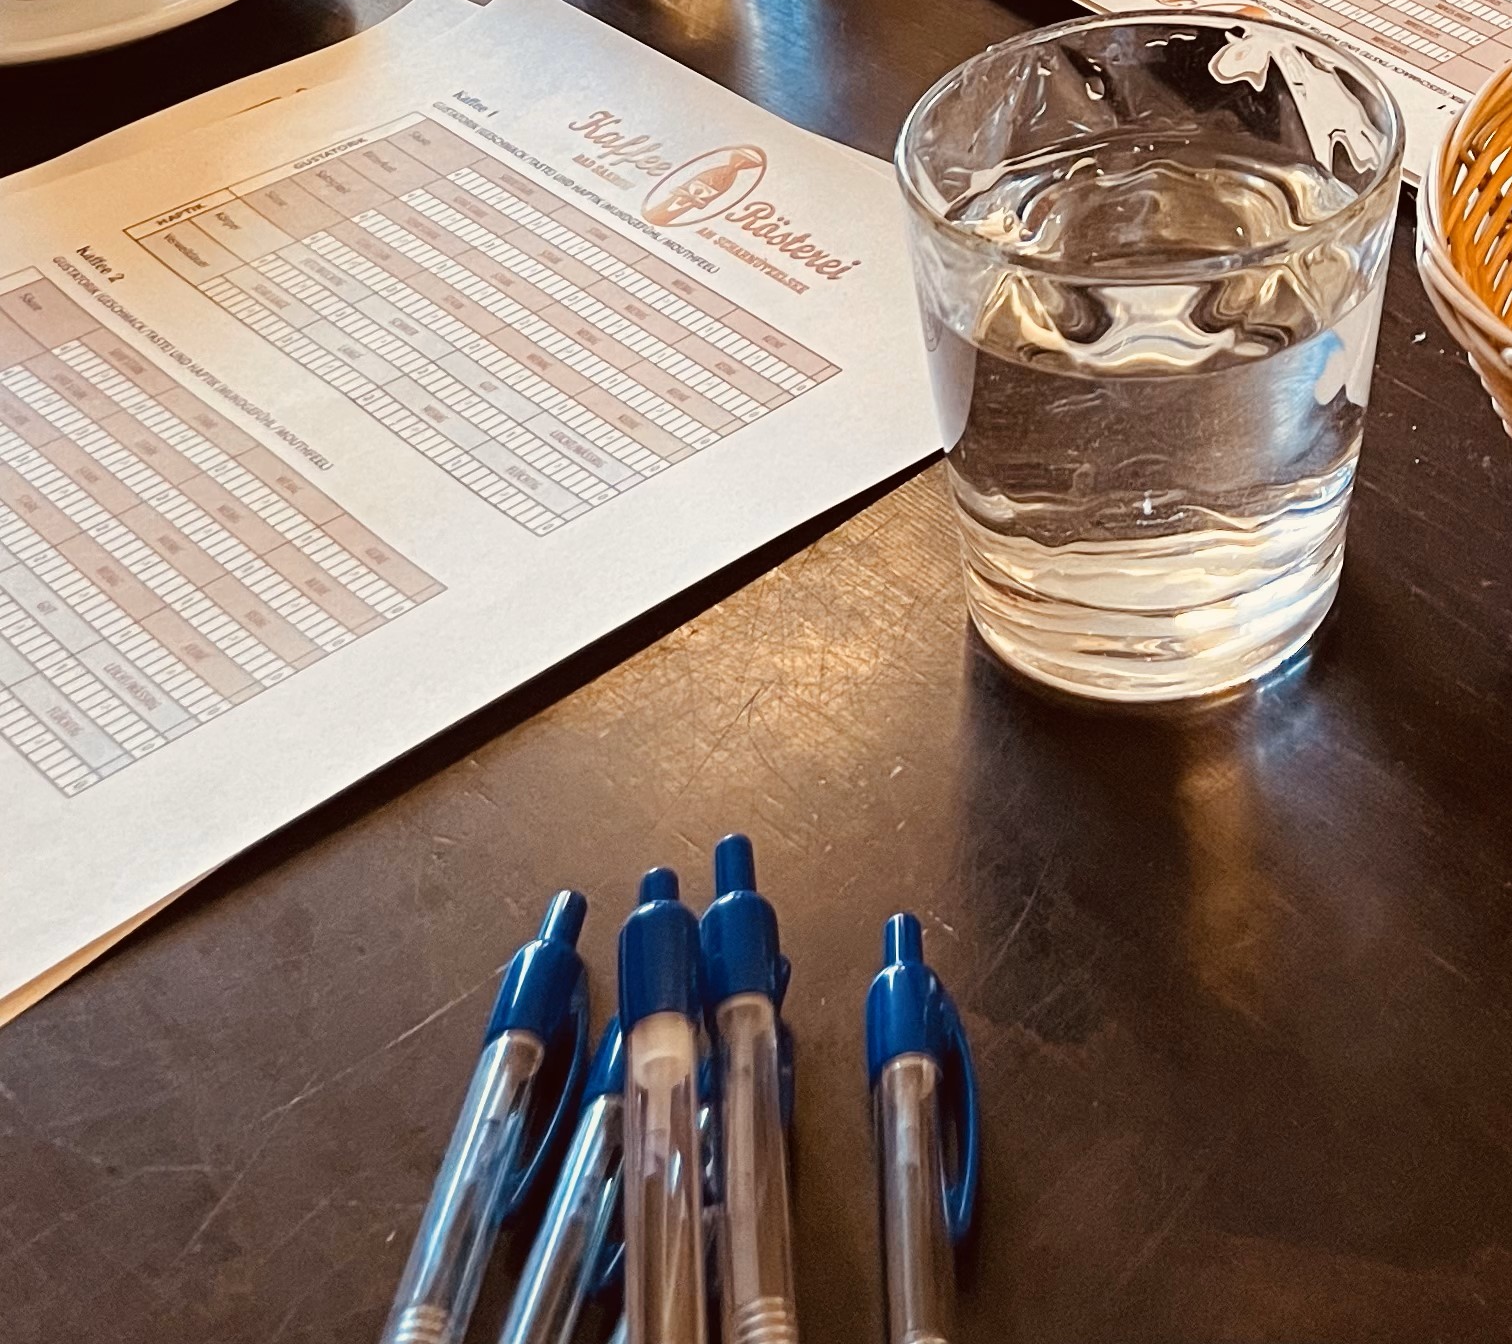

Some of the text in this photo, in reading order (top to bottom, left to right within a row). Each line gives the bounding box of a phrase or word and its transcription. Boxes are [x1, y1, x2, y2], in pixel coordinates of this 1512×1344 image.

[452, 90, 488, 113] Kaffee
[569, 110, 673, 177] Kaffee
[76, 245, 110, 276] Kaffee
[725, 200, 862, 281] Rösterei
